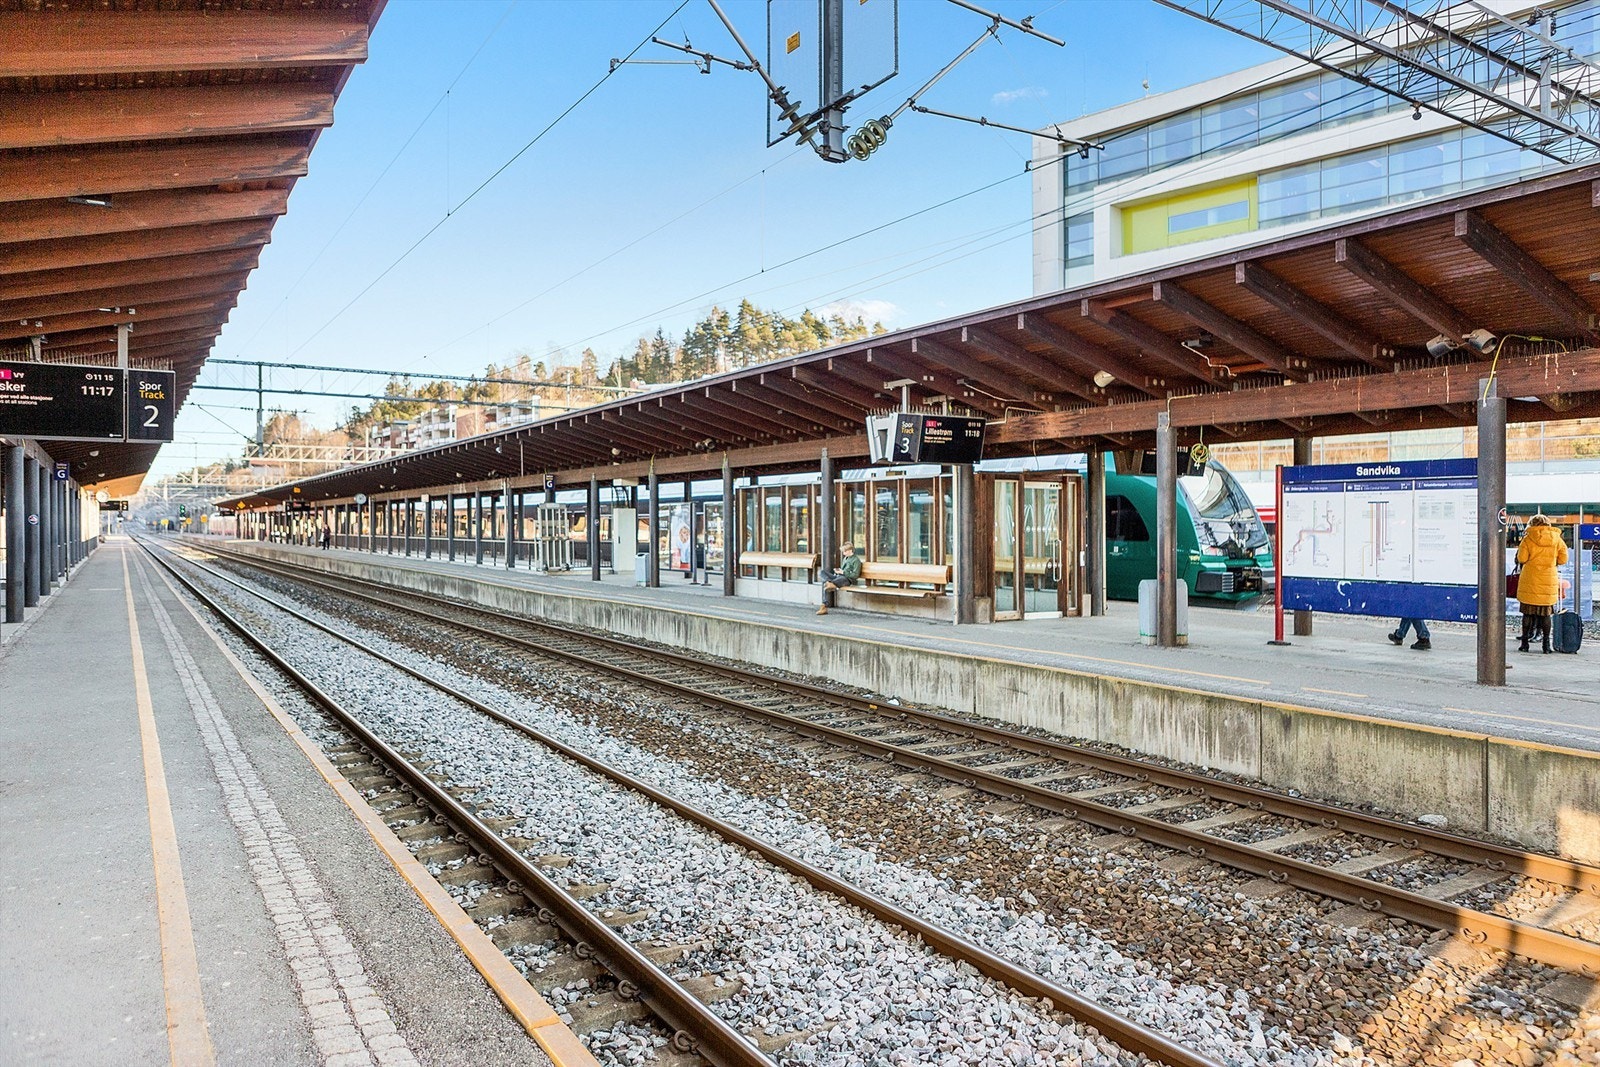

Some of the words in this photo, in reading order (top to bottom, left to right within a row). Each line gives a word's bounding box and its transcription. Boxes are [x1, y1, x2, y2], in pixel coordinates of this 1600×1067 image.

[81, 385, 114, 397] 11:17
[139, 381, 162, 391] Spor
[139, 390, 165, 399] Track
[143, 405, 159, 427] 2
[900, 437, 909, 453] 3
[57, 469, 66, 479] G
[1356, 465, 1400, 476] Sandvika
[1593, 526, 1600, 536] S
